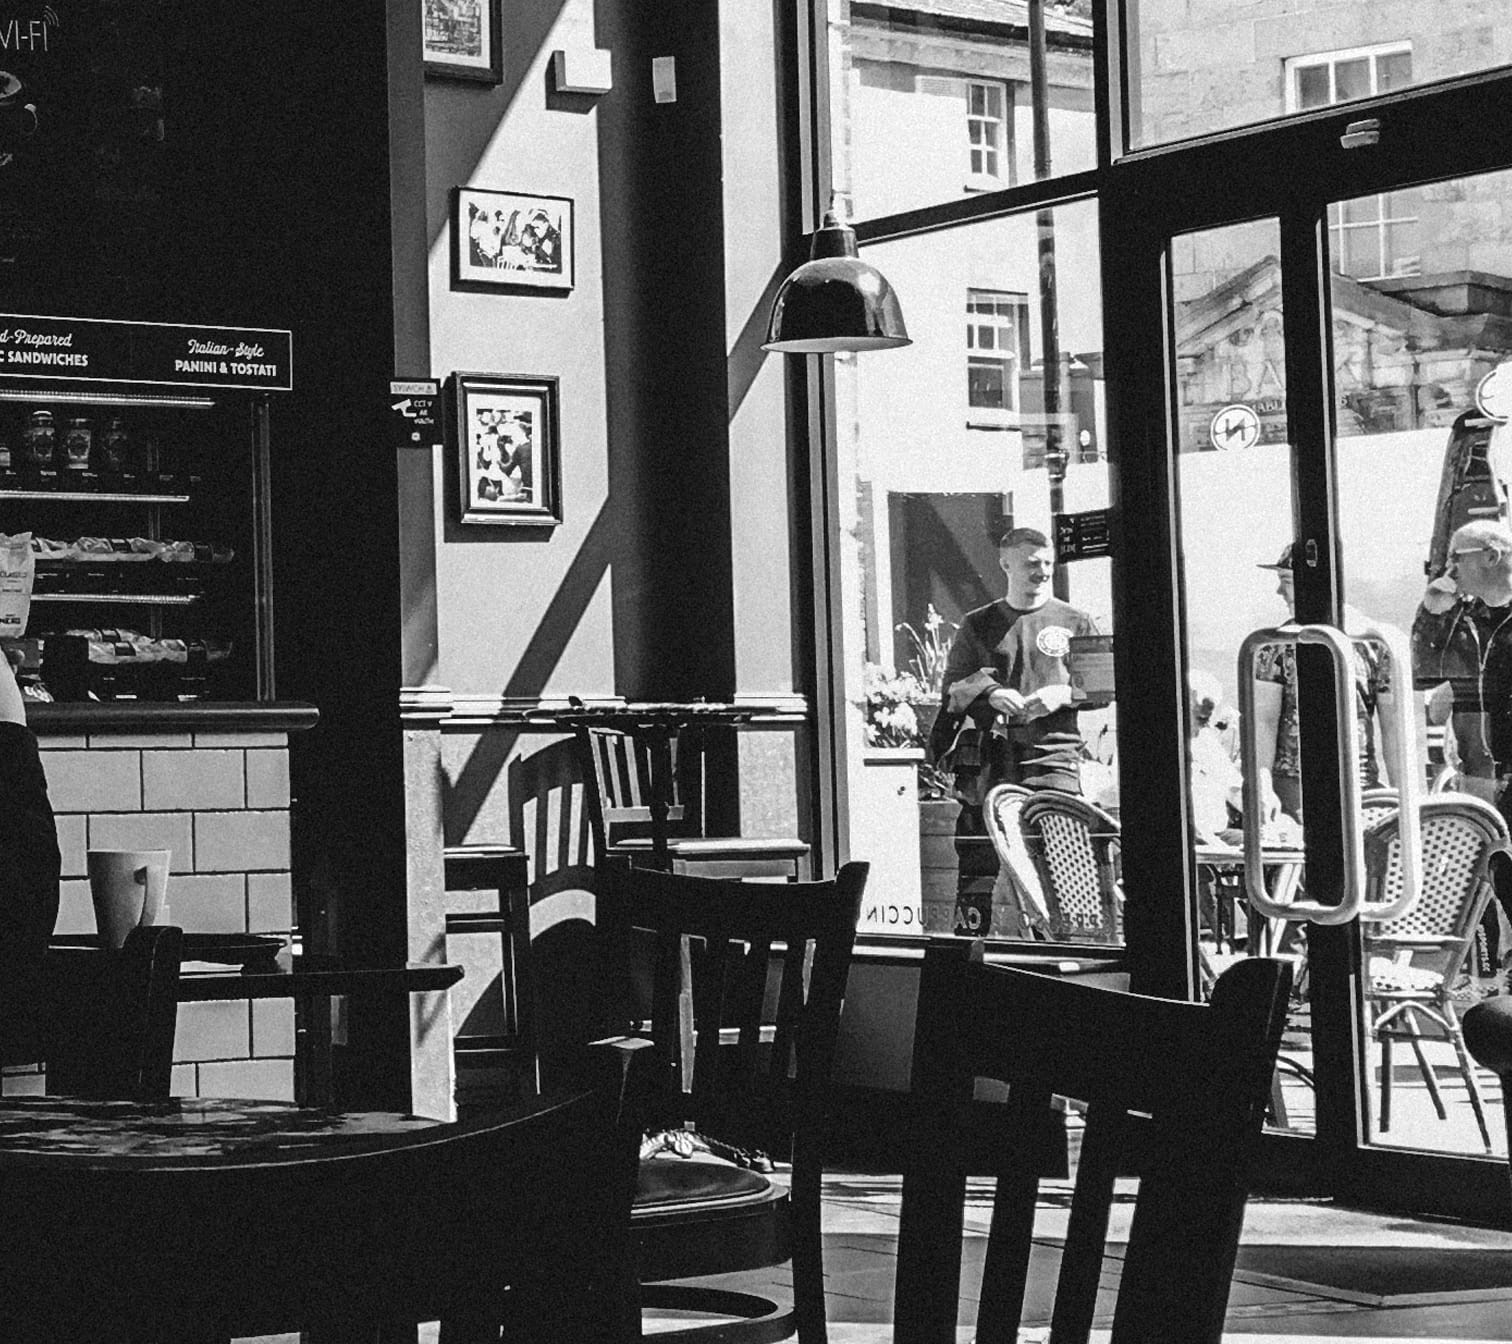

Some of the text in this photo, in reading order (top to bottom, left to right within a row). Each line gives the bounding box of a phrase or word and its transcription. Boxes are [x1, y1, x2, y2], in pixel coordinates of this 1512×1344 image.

[7, 350, 89, 367] SANDWICHES
[188, 338, 265, 361] Italian-Style
[174, 359, 278, 377] PANINI & TOSTATI
